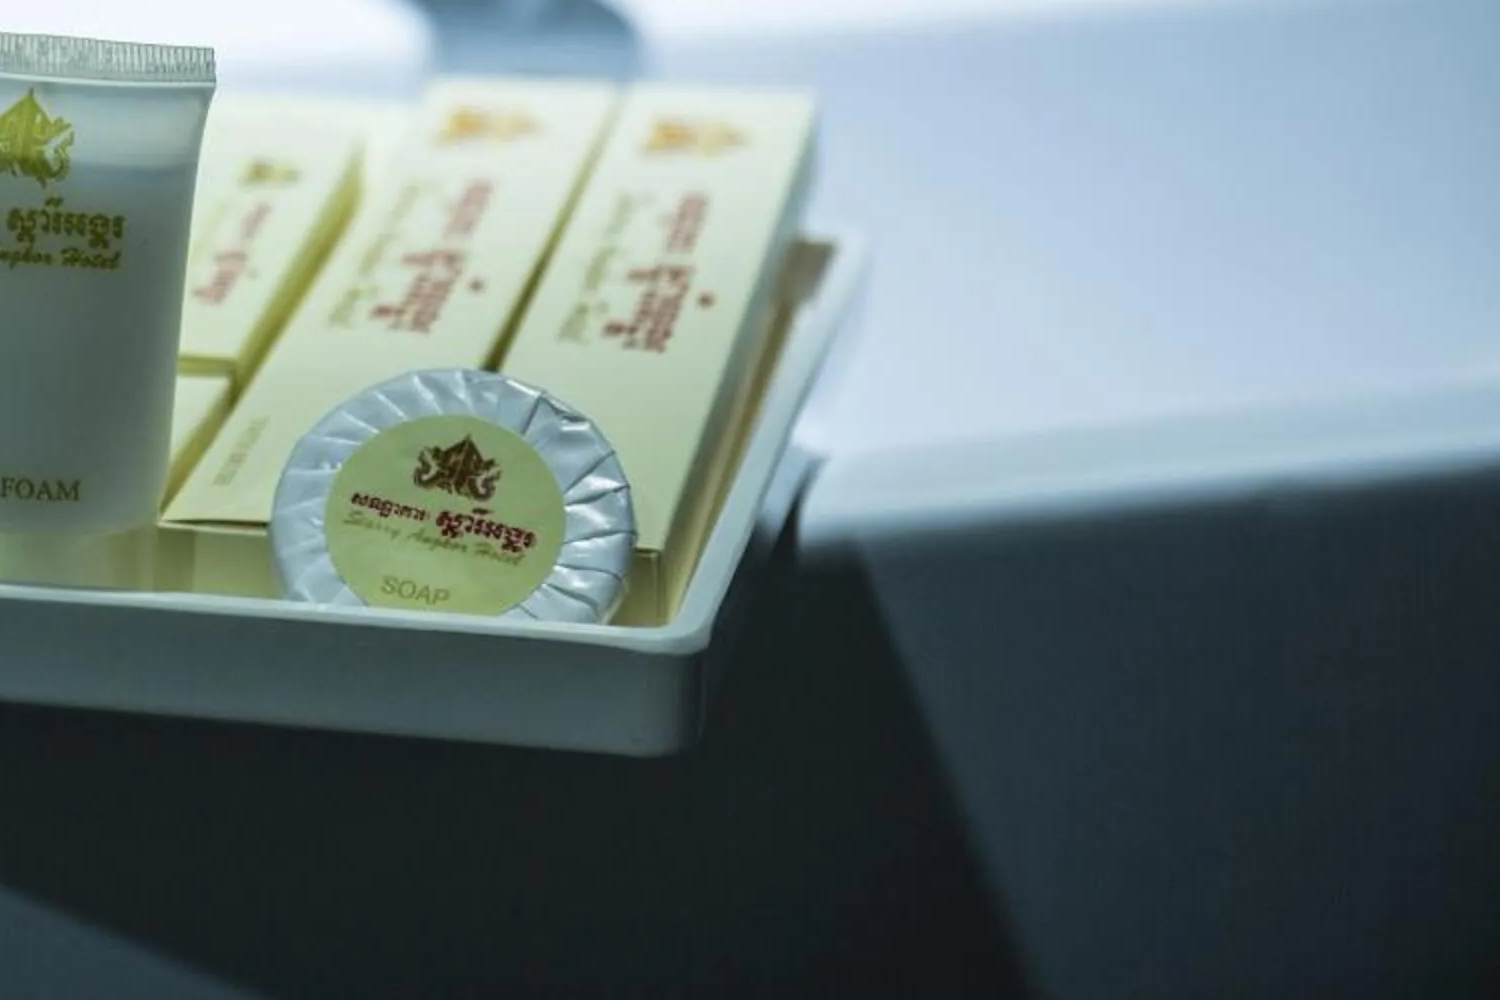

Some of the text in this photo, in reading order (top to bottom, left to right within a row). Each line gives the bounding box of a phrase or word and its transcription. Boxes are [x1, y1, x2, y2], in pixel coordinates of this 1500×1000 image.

[60, 246, 123, 271] Hotel
[0, 475, 82, 502] FOAM
[380, 574, 452, 605] SOAP
